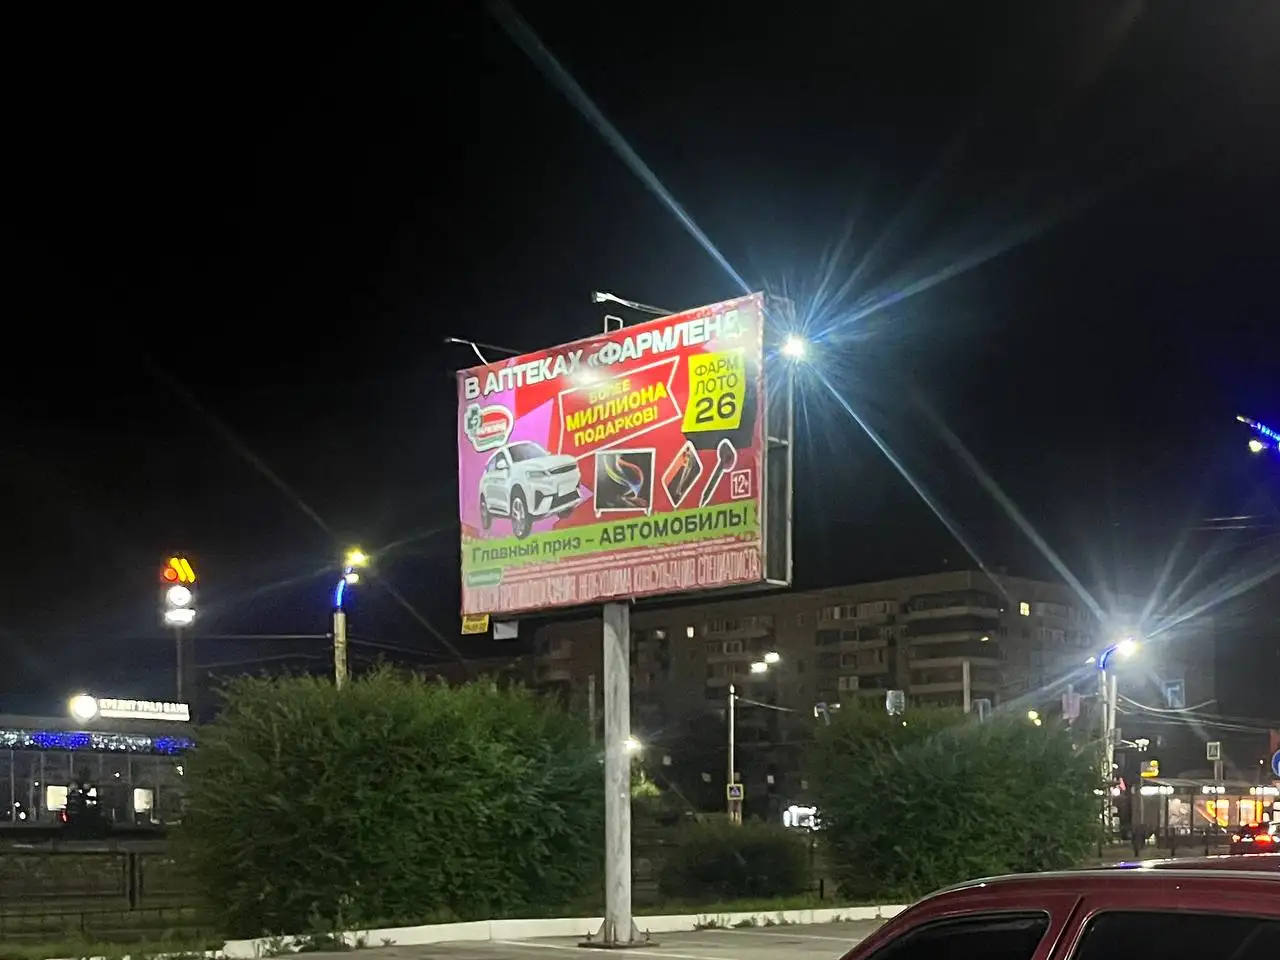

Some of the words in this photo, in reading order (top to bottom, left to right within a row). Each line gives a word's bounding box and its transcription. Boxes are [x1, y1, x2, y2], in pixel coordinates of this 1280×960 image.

[464, 375, 481, 400] В
[483, 349, 584, 396] АПТЕКАХ
[694, 357, 738, 377] ФАРМ
[695, 372, 738, 396] ЛОТО
[565, 380, 669, 432] МИЛЛИОНА
[694, 391, 737, 425] 26
[733, 474, 750, 496] 12+
[471, 541, 540, 563] Главный
[543, 531, 582, 557] приз
[599, 506, 749, 547] АВТОМОБИЛЬ!
